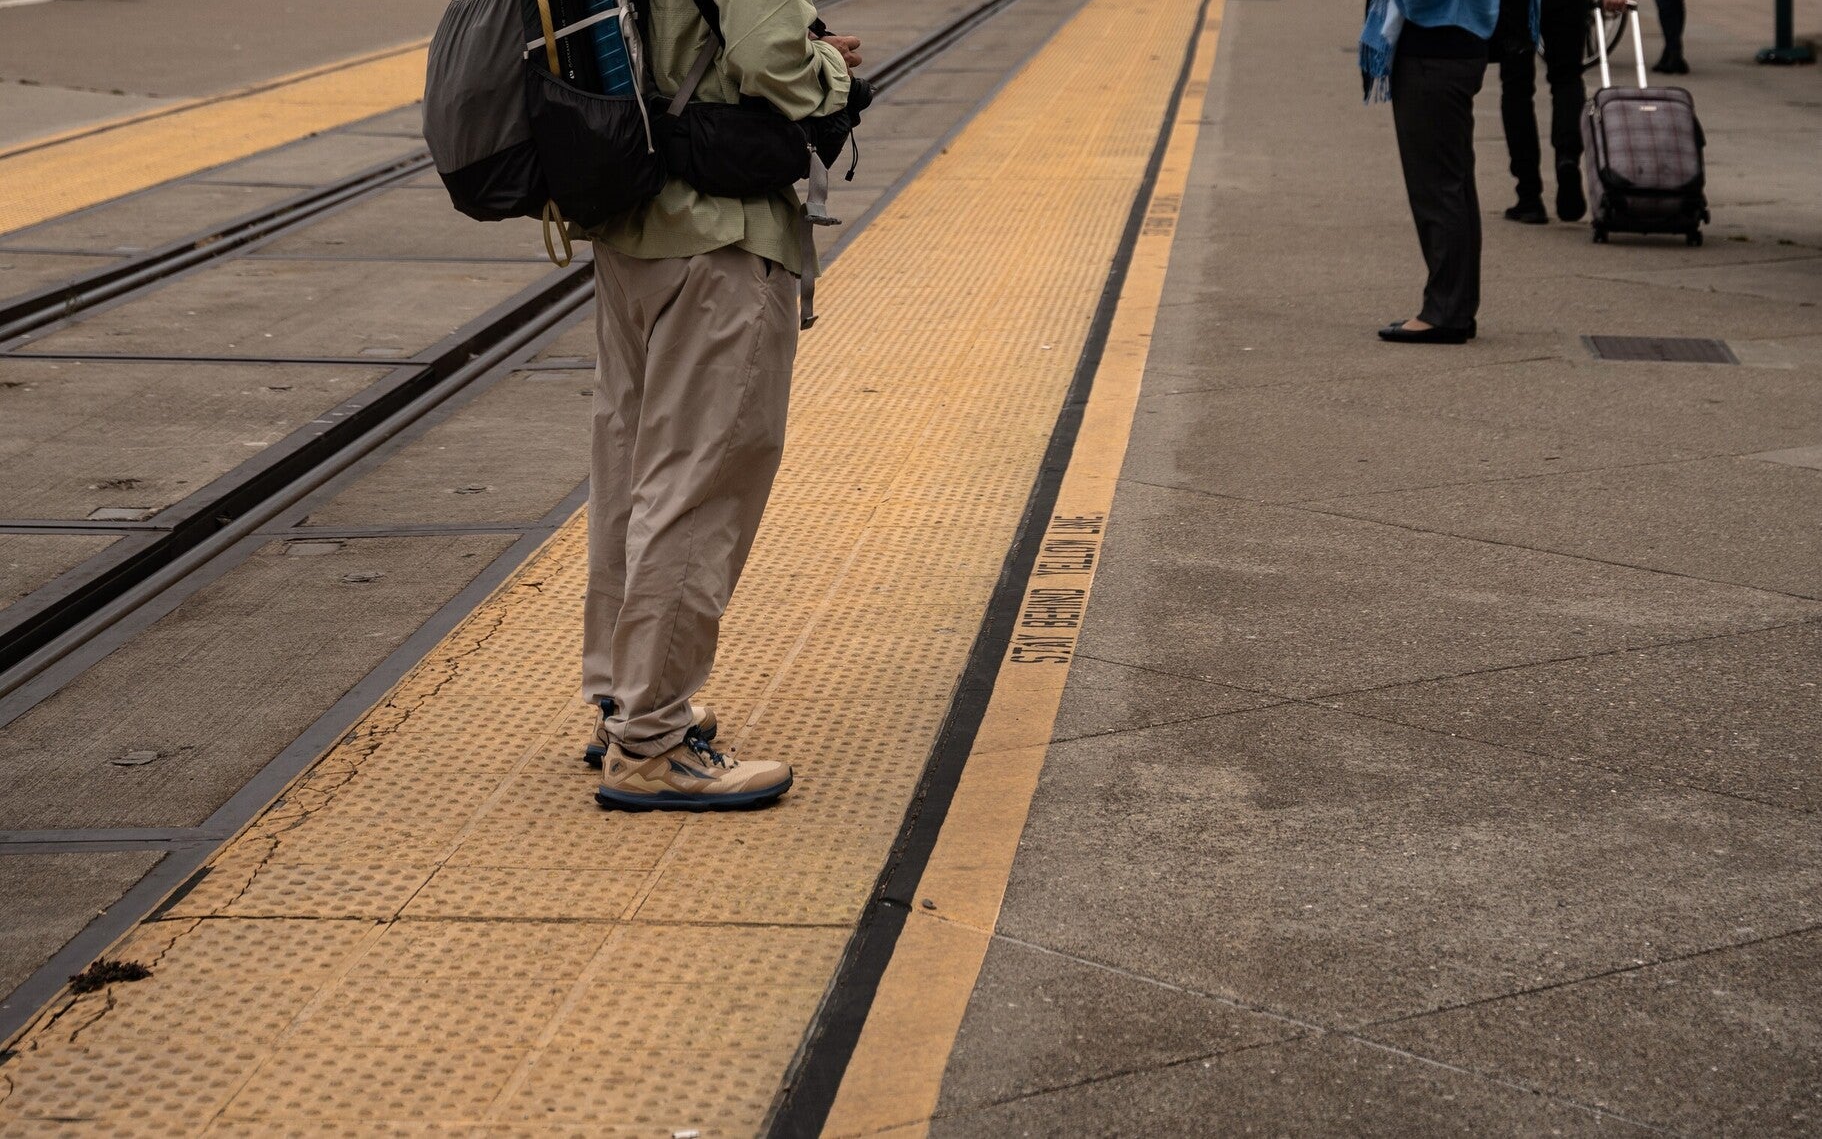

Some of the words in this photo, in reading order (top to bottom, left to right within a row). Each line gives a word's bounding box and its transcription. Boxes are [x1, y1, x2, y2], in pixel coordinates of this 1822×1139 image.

[1048, 515, 1104, 535] LINE
[1036, 538, 1097, 576] YELLOW
[1020, 588, 1085, 629] BEHIND
[1009, 633, 1074, 664] STAY
